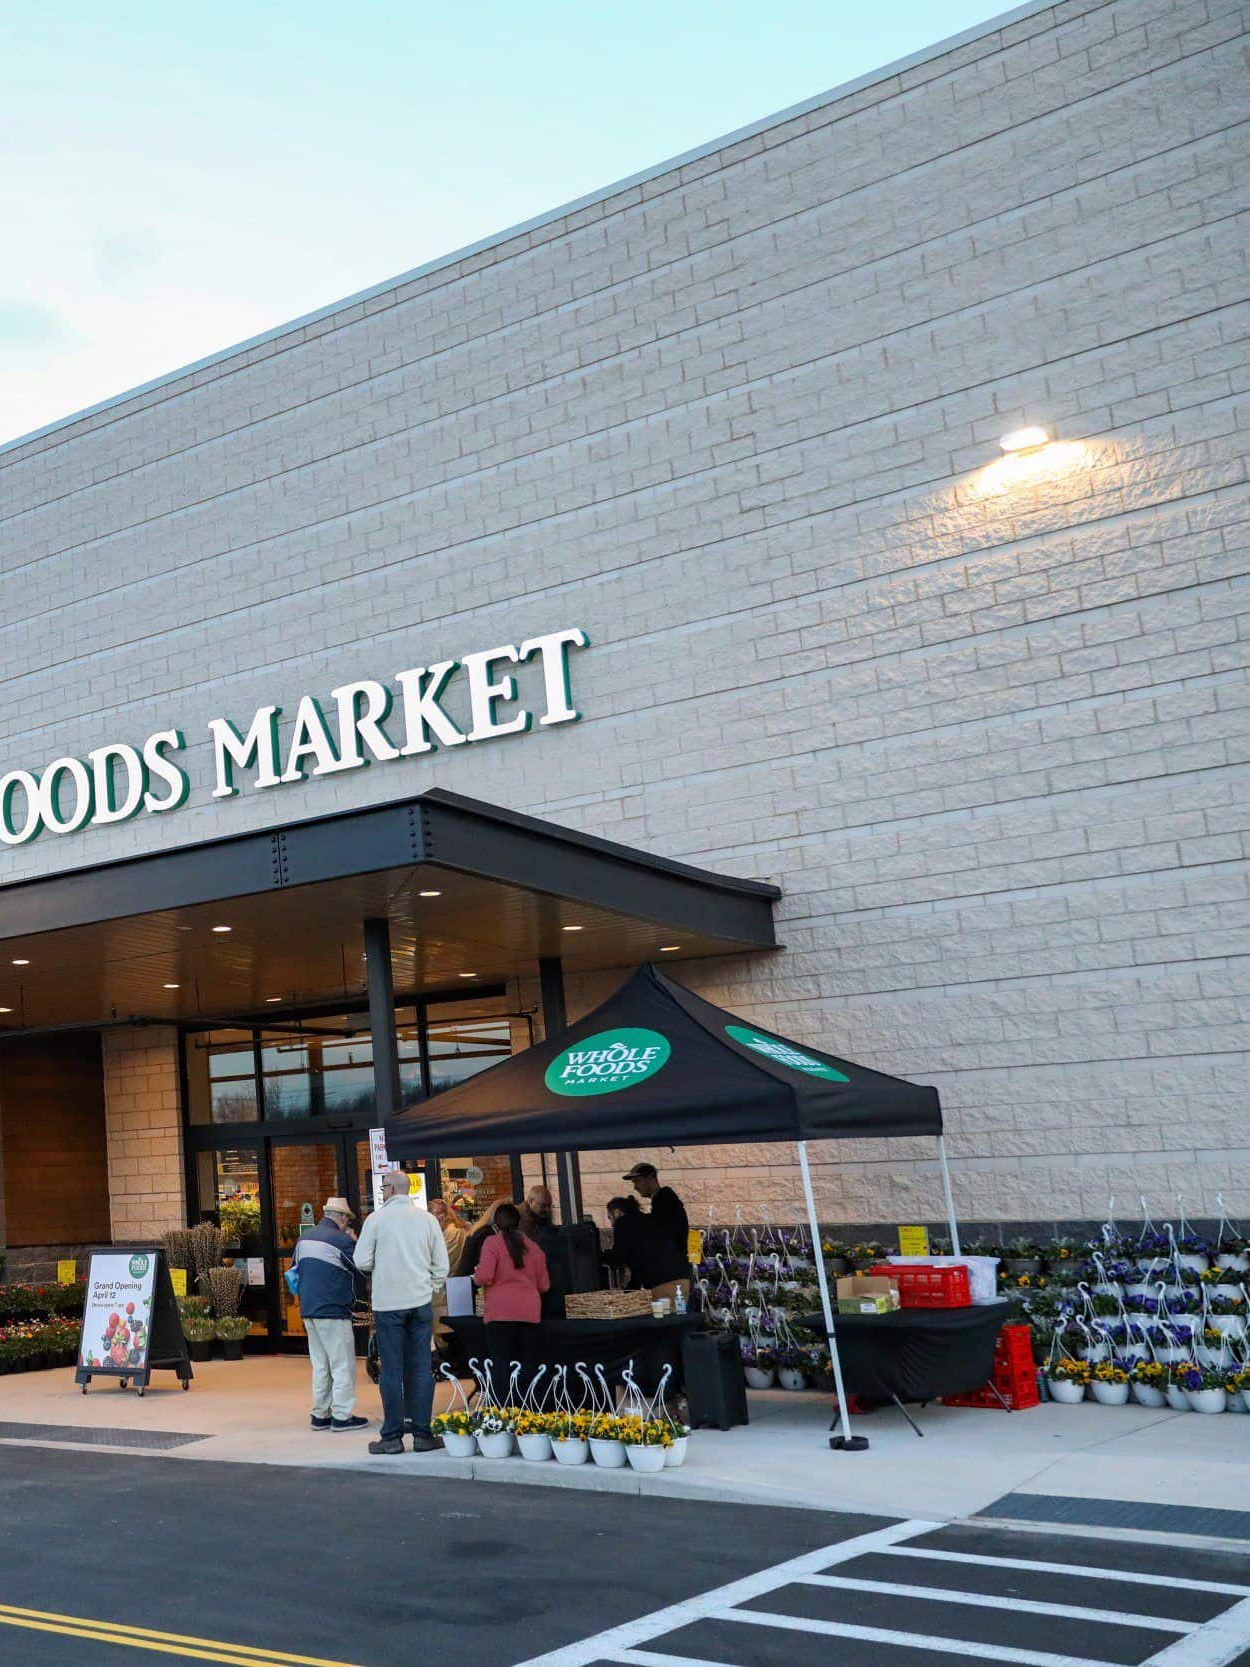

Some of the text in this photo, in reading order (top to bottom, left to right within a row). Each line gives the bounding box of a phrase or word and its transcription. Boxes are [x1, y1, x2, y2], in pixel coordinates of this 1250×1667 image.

[208, 629, 590, 798] MARKET
[568, 1043, 660, 1065] WHOLE
[559, 1060, 651, 1078] FOODS
[564, 1075, 630, 1085] MARKET
[94, 1281, 142, 1291] Grand Opening
[93, 1291, 108, 1299] April
